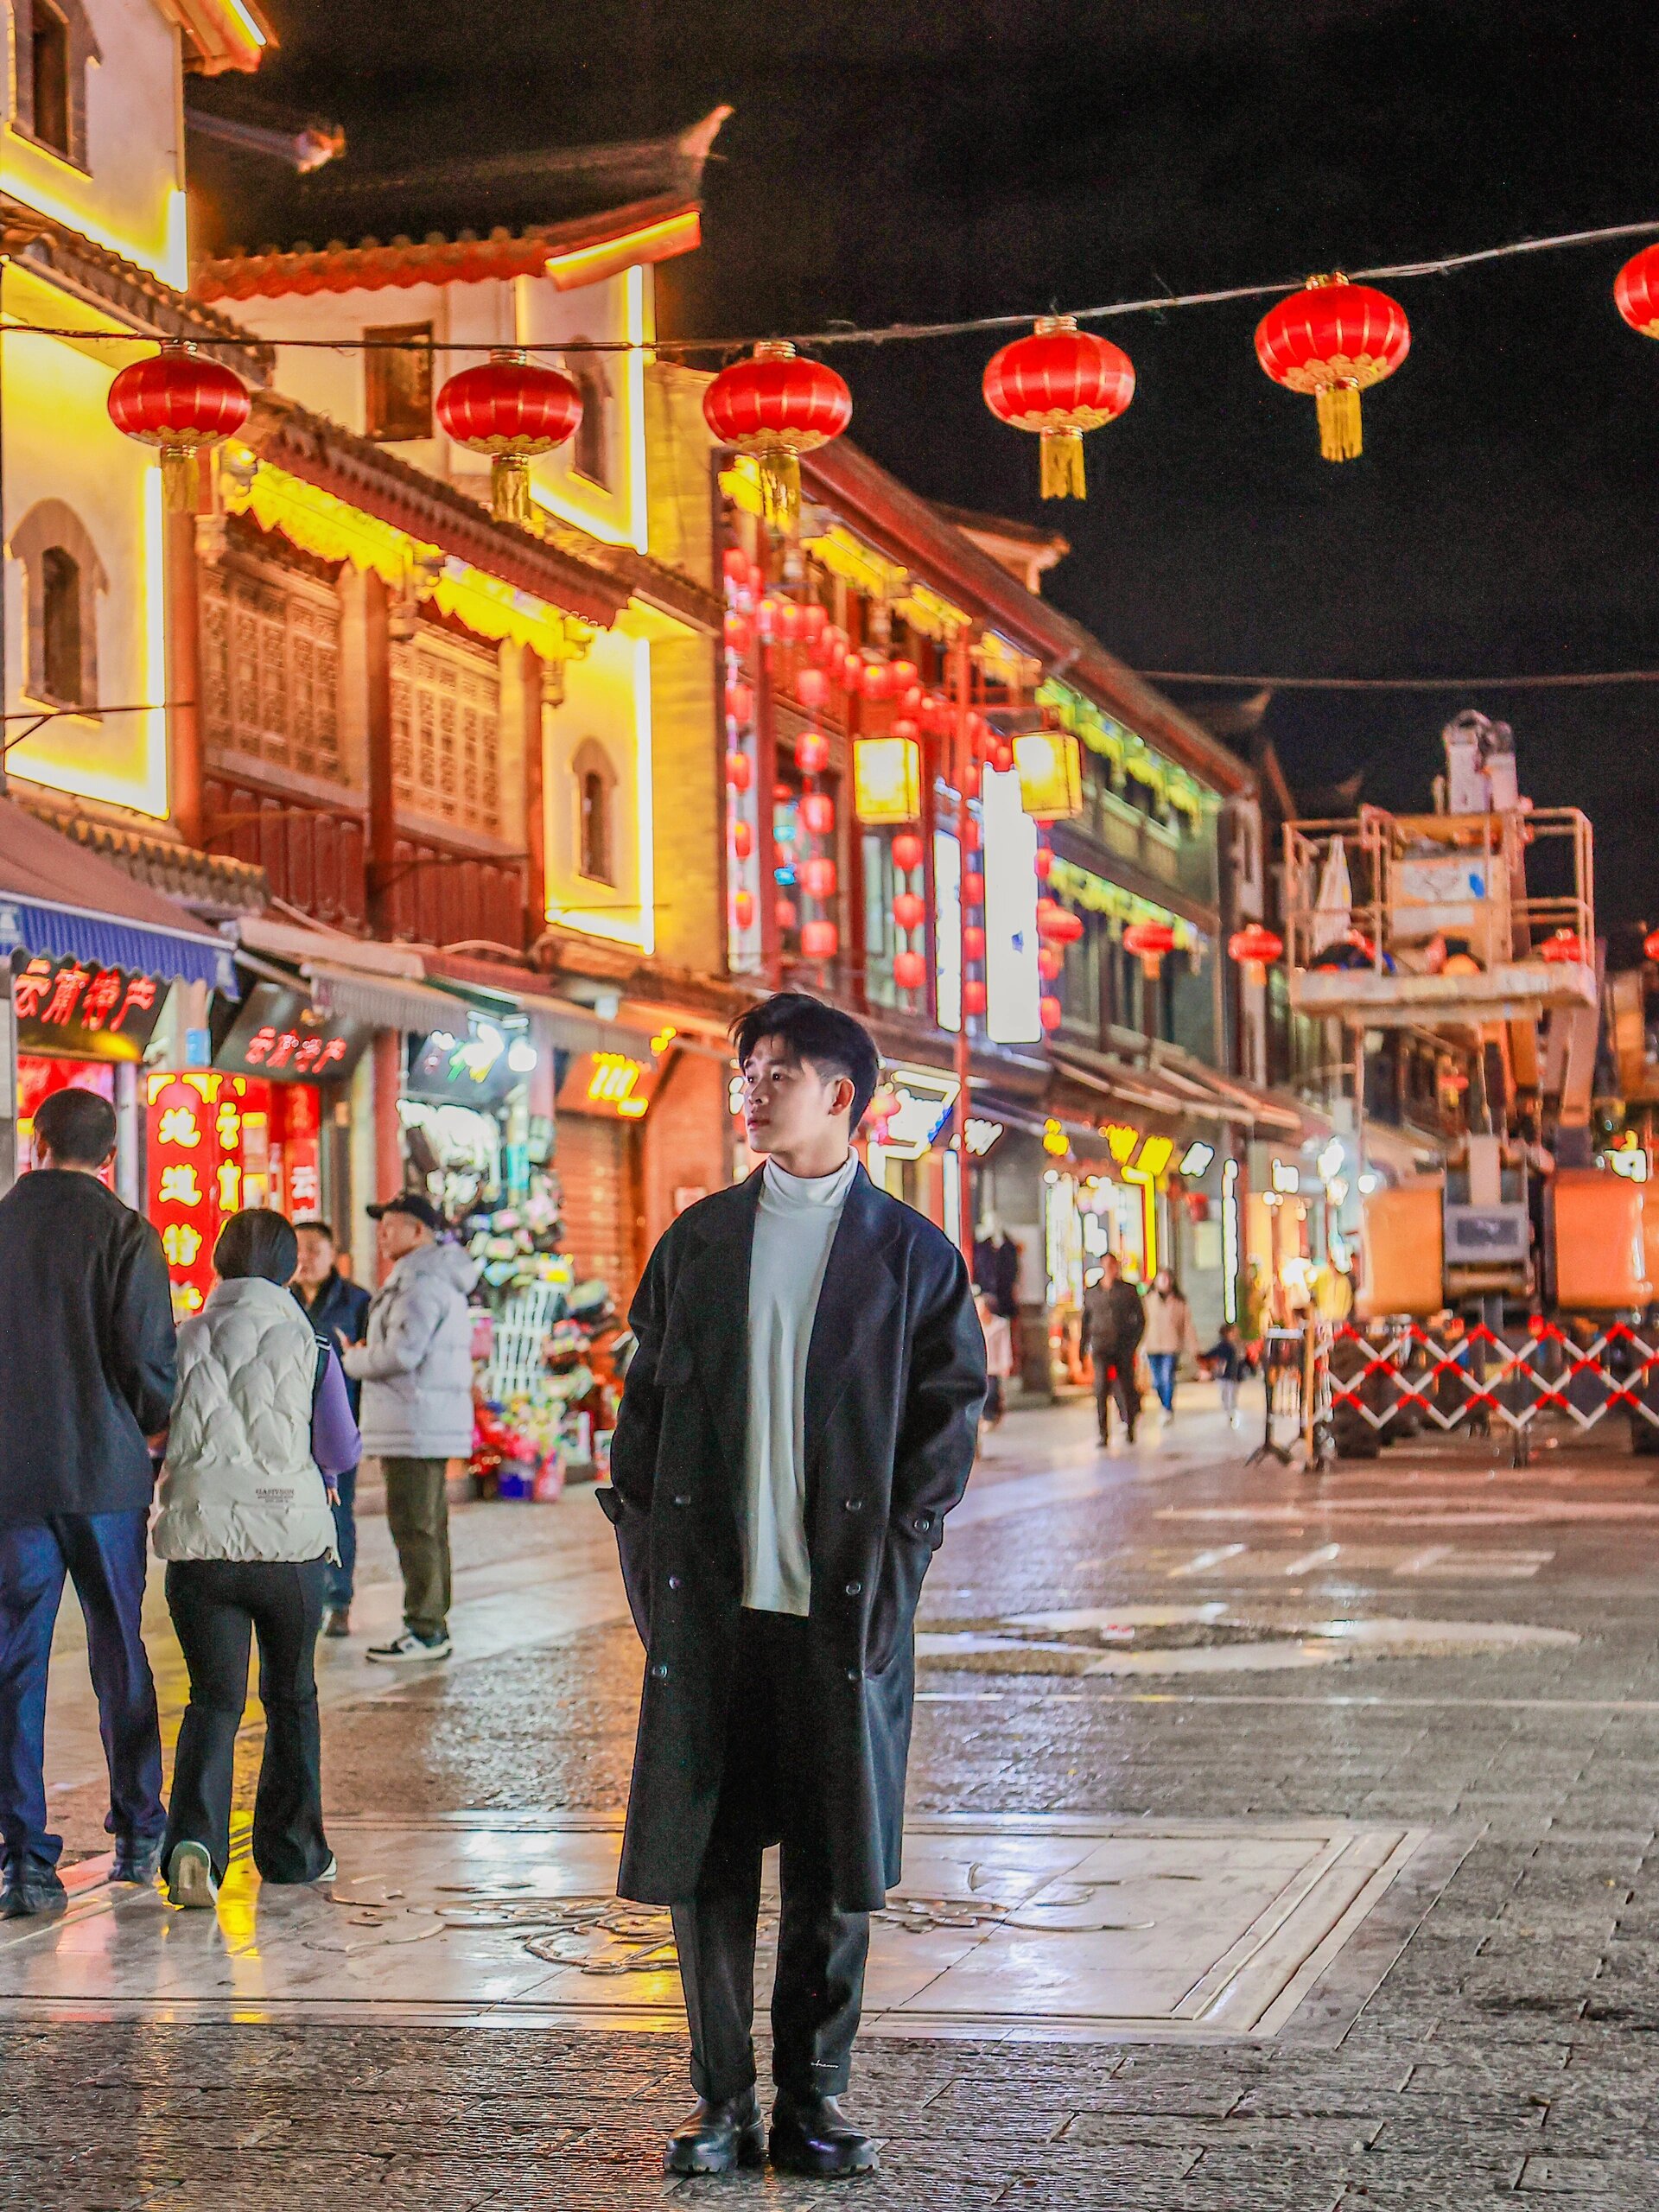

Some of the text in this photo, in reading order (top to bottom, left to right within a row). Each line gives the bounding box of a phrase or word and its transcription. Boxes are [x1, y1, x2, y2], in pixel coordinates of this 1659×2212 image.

[13, 957, 157, 1033] 云南特产
[245, 1026, 346, 1075] 云南特产
